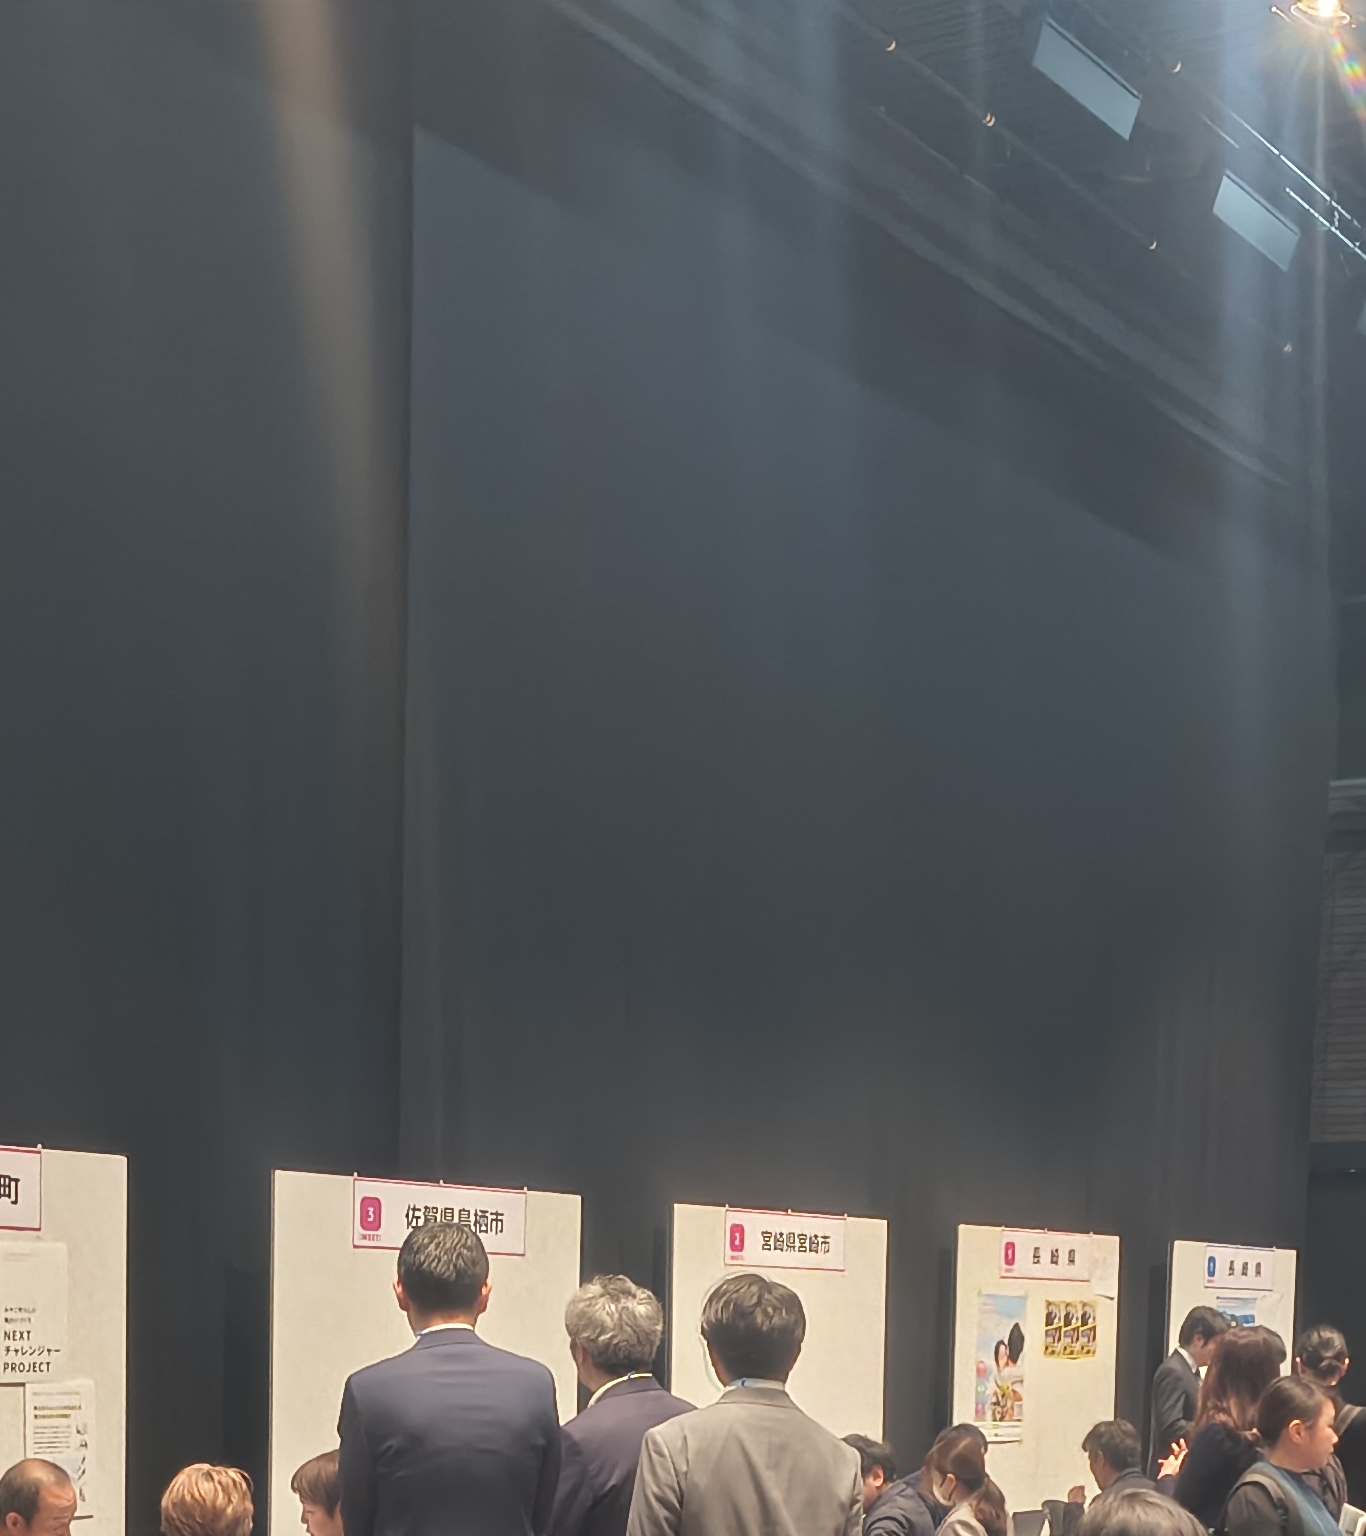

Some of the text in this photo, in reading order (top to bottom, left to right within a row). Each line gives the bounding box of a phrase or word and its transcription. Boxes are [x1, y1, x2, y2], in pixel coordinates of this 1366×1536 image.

[367, 1206, 375, 1222] 3
[3, 1329, 32, 1342] NEXT
[4, 1345, 61, 1357] チャレンジャー
[2, 1361, 51, 1374] PROJECT
